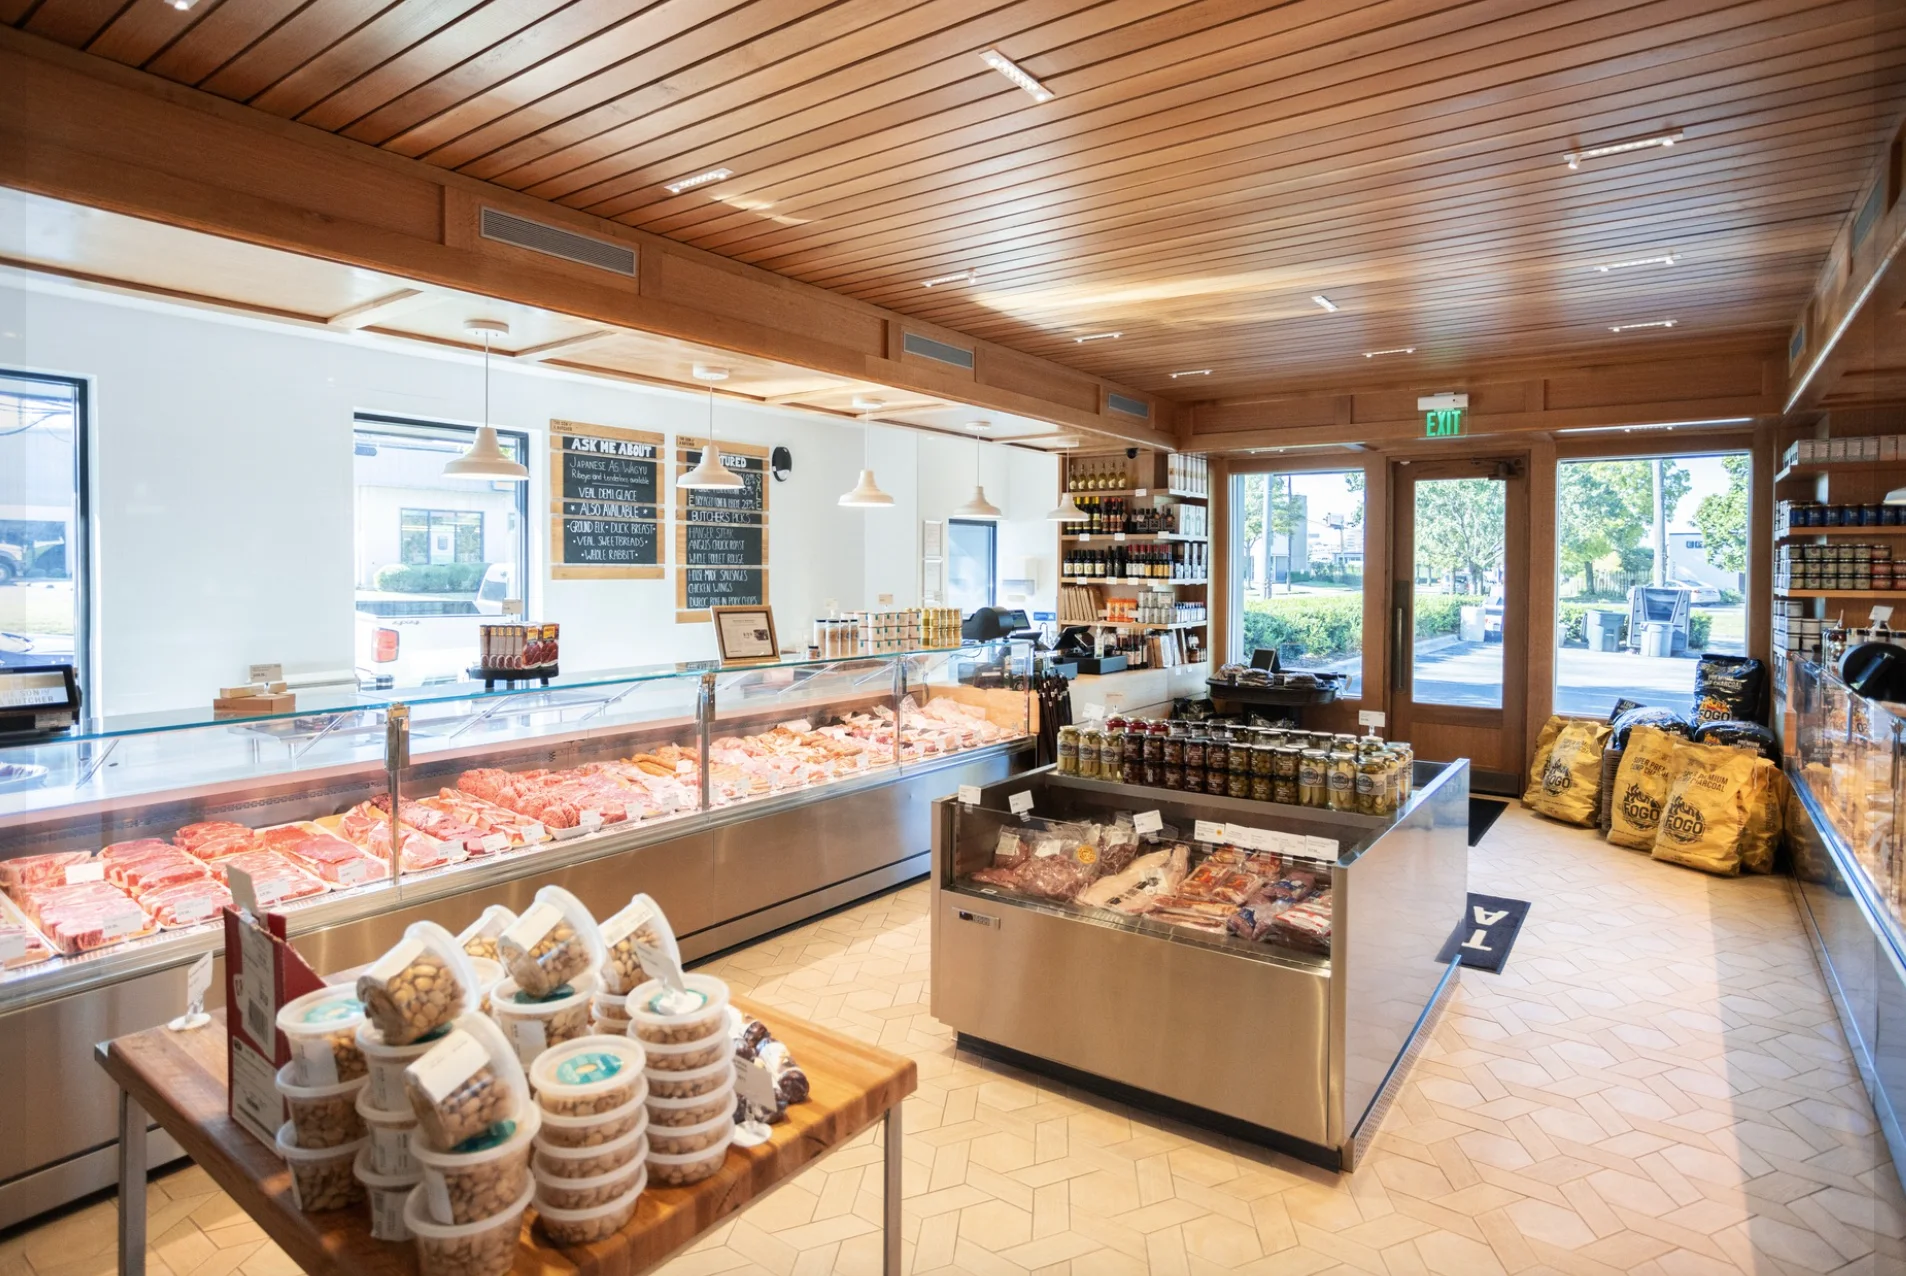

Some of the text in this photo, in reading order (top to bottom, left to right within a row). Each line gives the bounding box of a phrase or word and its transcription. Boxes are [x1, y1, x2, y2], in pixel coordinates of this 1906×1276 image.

[1426, 409, 1461, 437] EXIT
[571, 438, 652, 457] ASK ME ABOUT
[570, 457, 606, 471] JAPANESE
[622, 461, 648, 475] WAGYU
[719, 456, 747, 468] TURED
[572, 469, 592, 483] Ribeye
[592, 472, 602, 481] and
[630, 476, 650, 485] available
[578, 487, 637, 502] VEAL DEMI GLACE
[580, 503, 640, 519] ALSO AVAILABLE
[732, 512, 751, 524] PICKS
[569, 520, 654, 535] GROUND ELK DUCK BREAST
[688, 527, 734, 539] HANGER STEAK
[577, 536, 645, 548] VEAL SWEETBREADS
[688, 540, 745, 551] ANGUS CHUCK ROAST
[584, 549, 636, 560] WHOLE RABBIT
[688, 553, 706, 564] WHOLE
[726, 553, 744, 564] ROUGE
[720, 569, 748, 582] SAUSAGES
[688, 582, 733, 593] CHICKEN WINGS
[689, 596, 709, 608] DUROC
[741, 596, 757, 605] CHOPS
[1699, 709, 1730, 721] FOGO
[1624, 801, 1660, 821] FOGO
[1664, 815, 1704, 835] FOGO
